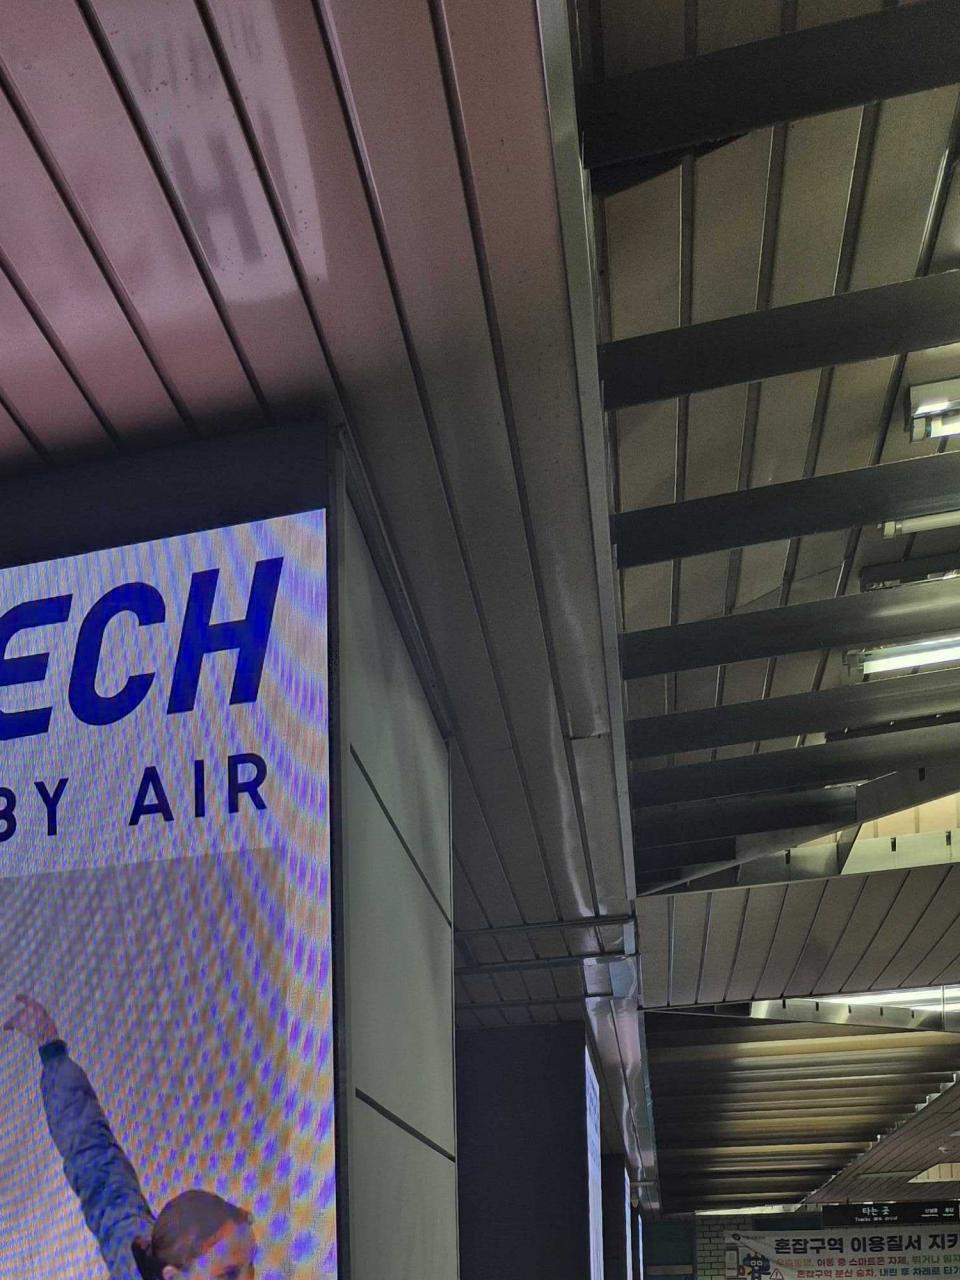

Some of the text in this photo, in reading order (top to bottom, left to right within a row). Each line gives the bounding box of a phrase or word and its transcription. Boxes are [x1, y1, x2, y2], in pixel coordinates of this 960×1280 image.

[128, 752, 268, 827] AIR
[862, 1206, 878, 1216] 타는
[881, 1206, 890, 1215] 곳
[774, 1237, 844, 1254] 혼잡구역
[851, 1234, 922, 1253] 이용질서
[849, 1256, 885, 1266] 스마트폰
[797, 1269, 833, 1278] 혼잡구역
[912, 1267, 940, 1275] 차례로
